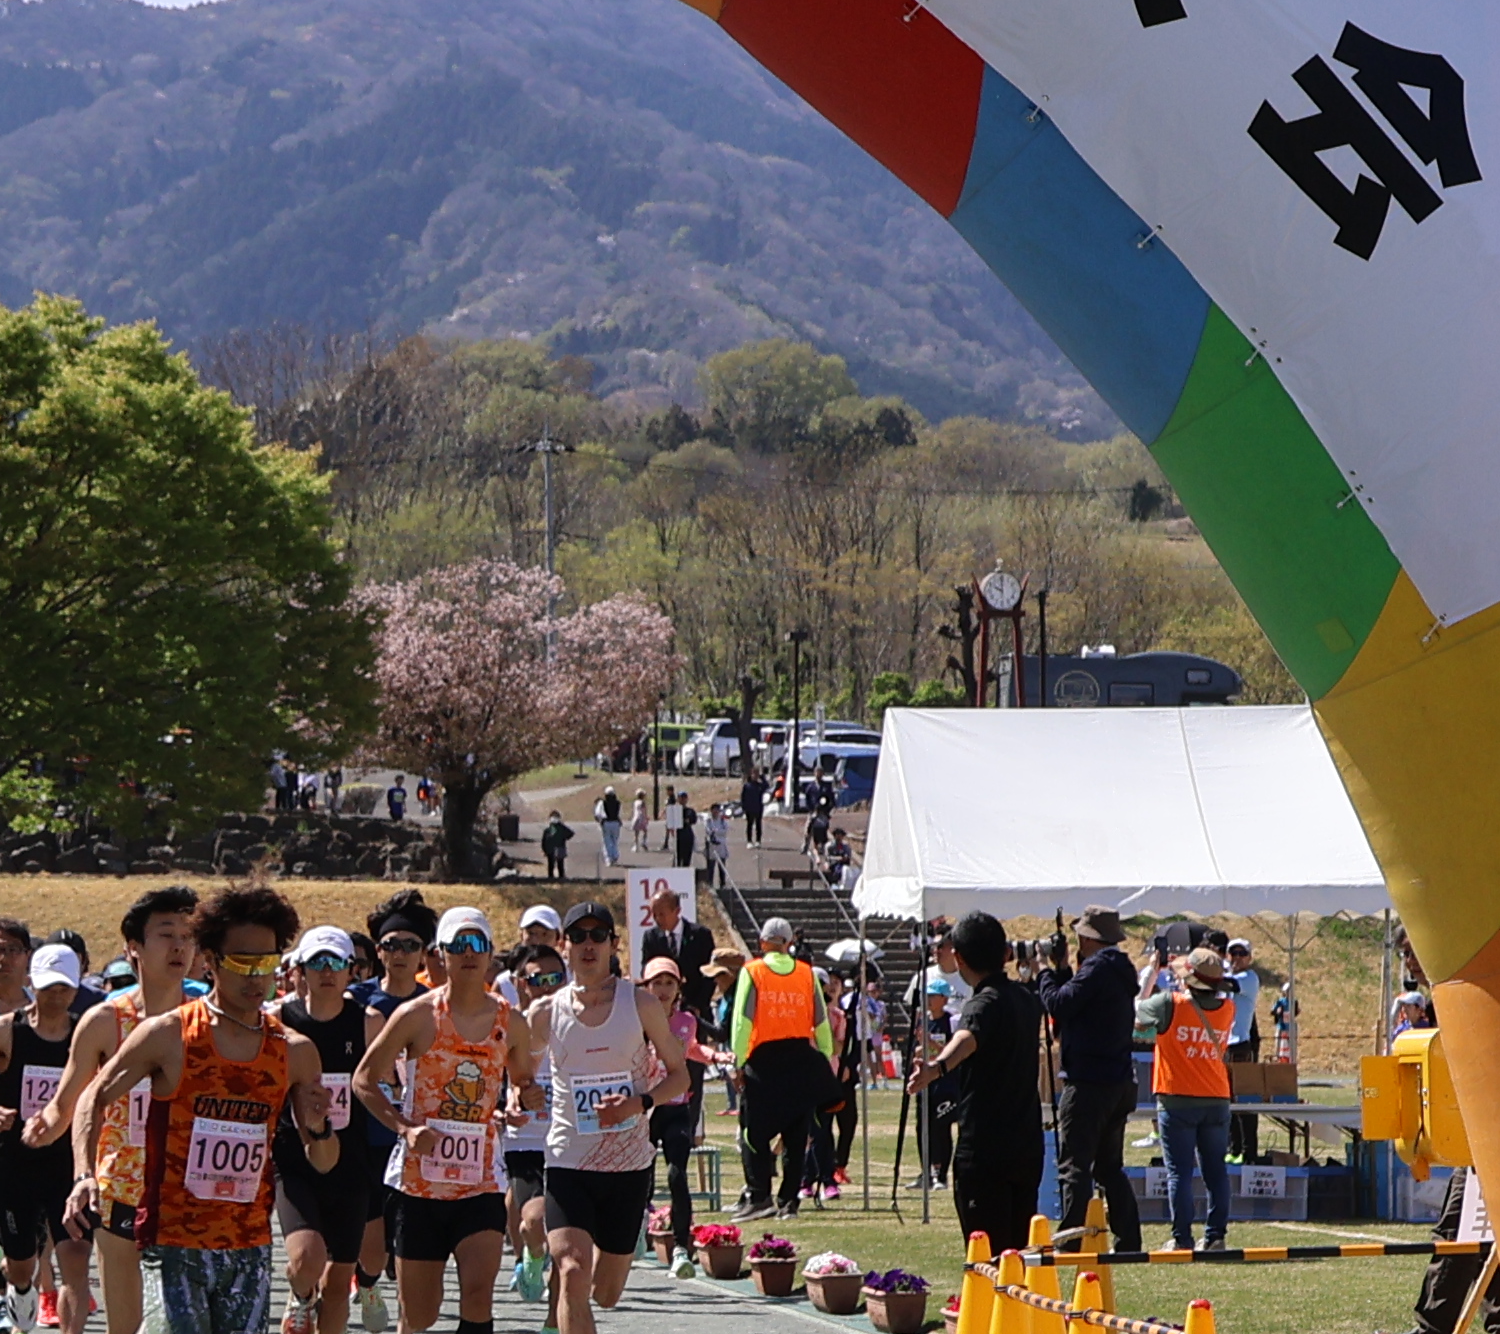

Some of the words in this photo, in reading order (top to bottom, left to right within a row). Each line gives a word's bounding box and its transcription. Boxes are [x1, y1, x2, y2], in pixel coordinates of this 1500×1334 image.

[193, 1096, 271, 1121] UNITED
[439, 1101, 483, 1122] SSR
[196, 1138, 264, 1173] 1005
[431, 1136, 479, 1162] 001
